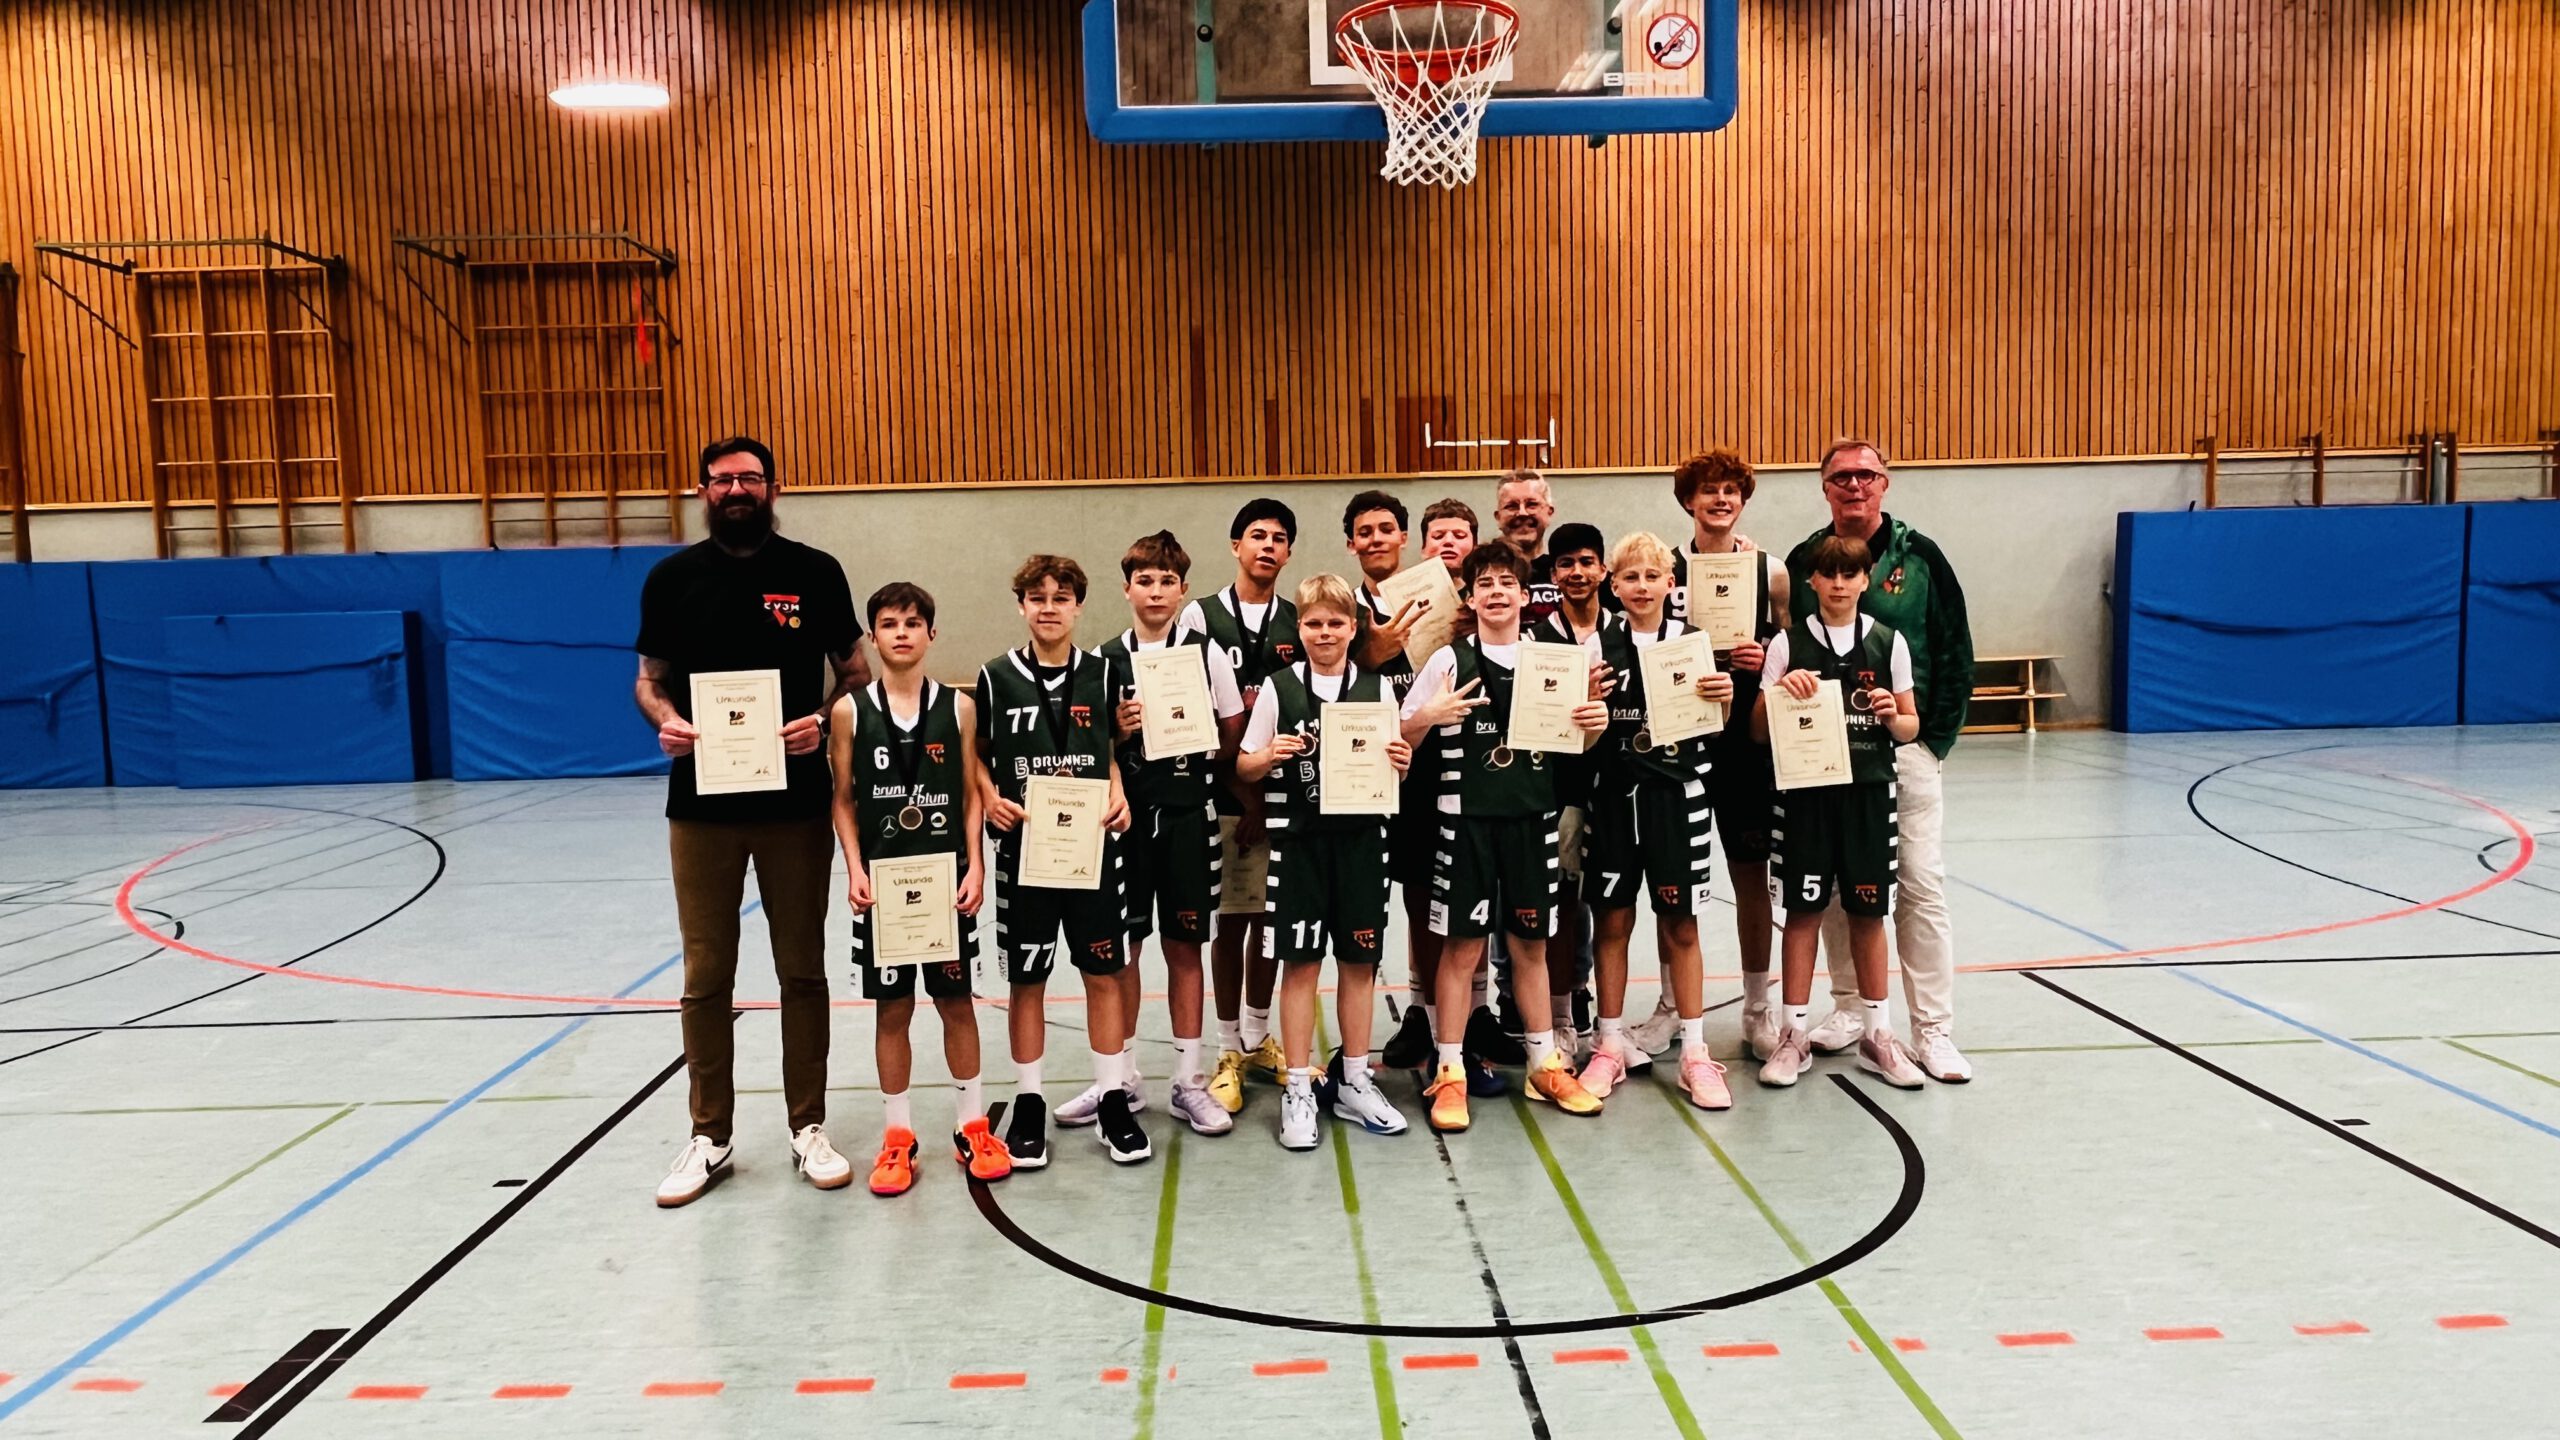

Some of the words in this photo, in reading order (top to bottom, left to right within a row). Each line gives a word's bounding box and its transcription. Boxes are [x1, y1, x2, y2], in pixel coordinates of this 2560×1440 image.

[1670, 586, 1687, 617] 9
[1006, 706, 1039, 733] 77
[874, 747, 889, 770] 6
[1032, 754, 1095, 768] BRUNNER
[917, 793, 949, 806] blum
[1602, 872, 1620, 897] 7
[1802, 875, 1821, 901] 5
[1470, 900, 1489, 925] 4
[1292, 920, 1321, 949] 11
[1020, 941, 1056, 971] 77
